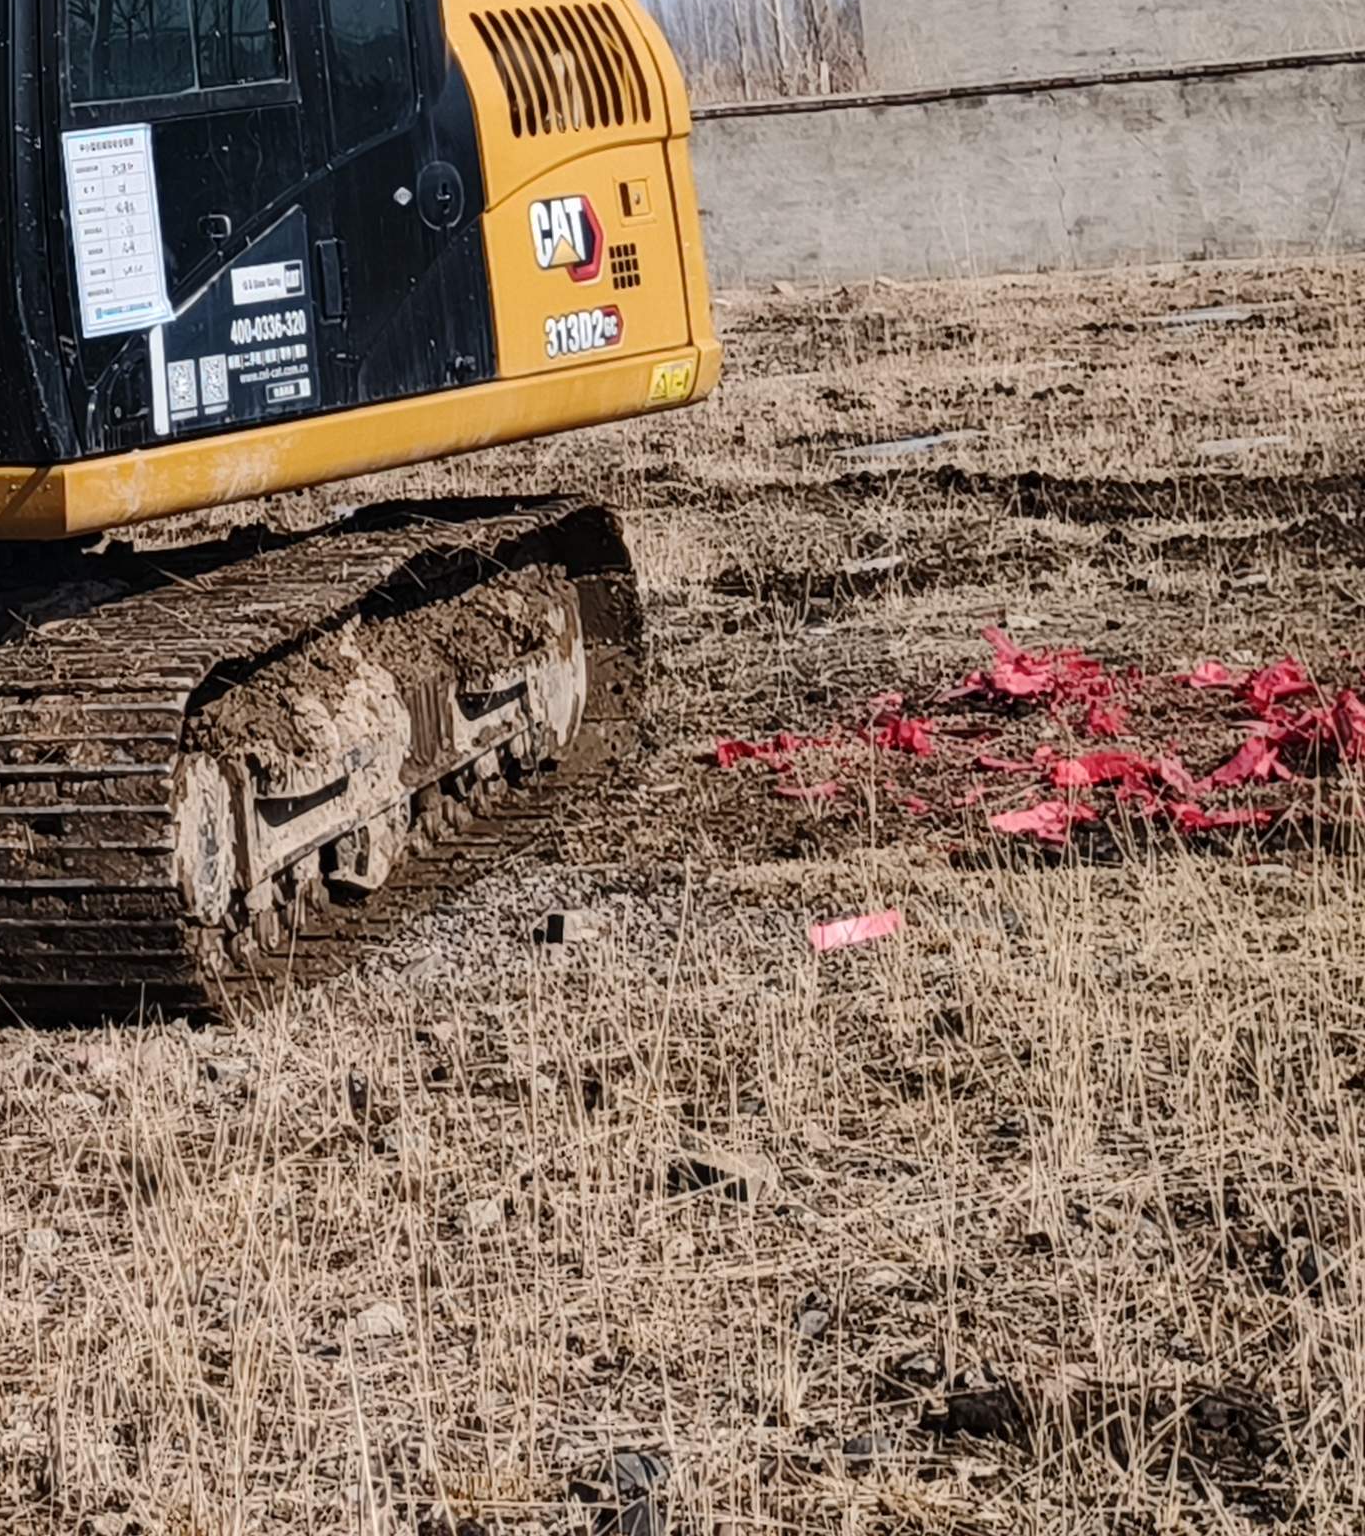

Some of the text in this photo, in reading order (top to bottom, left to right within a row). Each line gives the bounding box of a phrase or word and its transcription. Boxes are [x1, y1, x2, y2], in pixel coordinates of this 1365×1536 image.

[529, 196, 587, 269] CAT
[230, 309, 307, 345] 400-0336-320
[545, 308, 605, 357] 313D2
